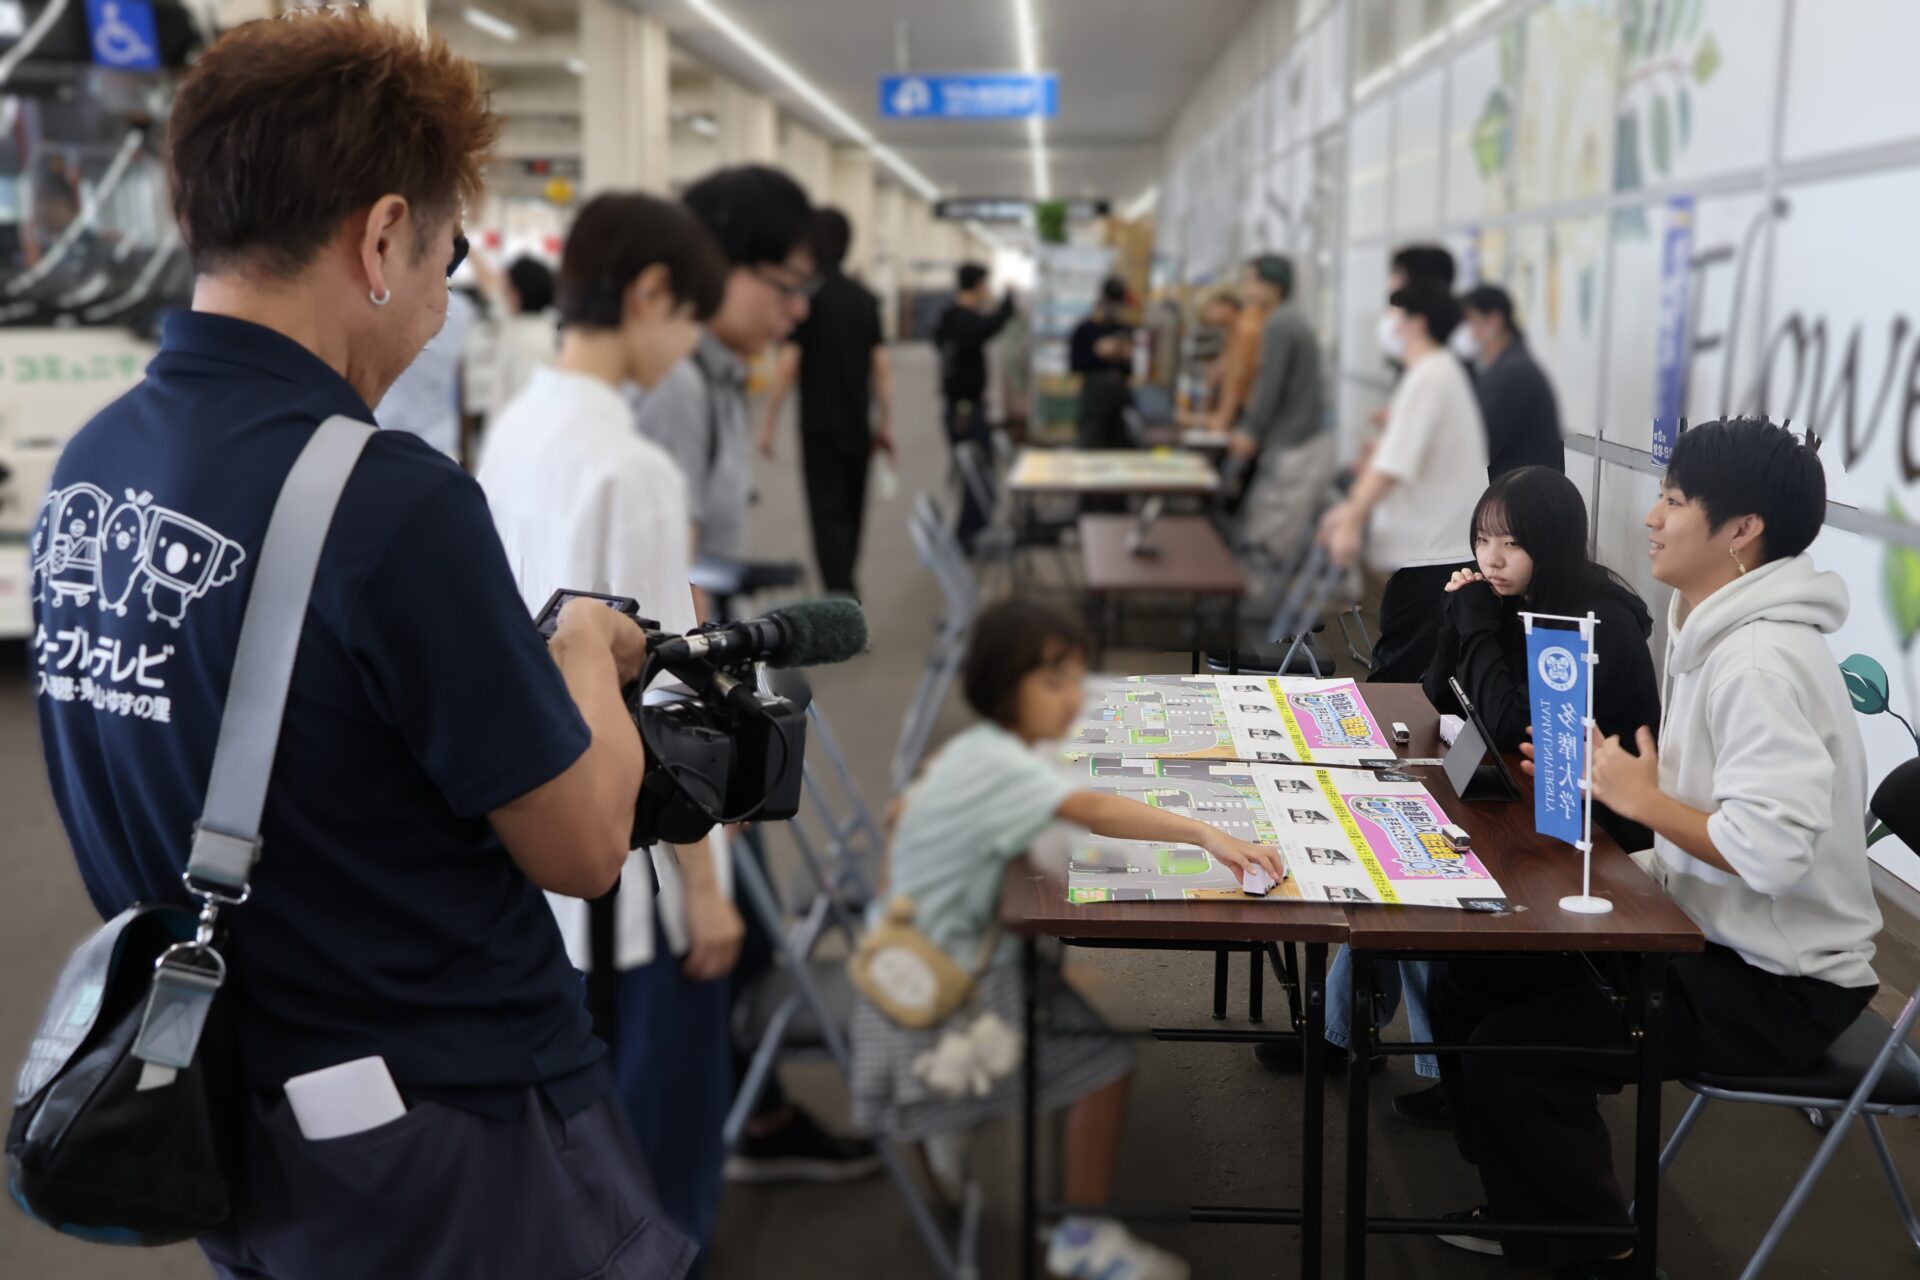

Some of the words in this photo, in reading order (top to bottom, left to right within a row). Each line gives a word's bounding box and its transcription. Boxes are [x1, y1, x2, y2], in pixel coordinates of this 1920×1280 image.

[35, 623, 175, 689] ケーブルテレビ
